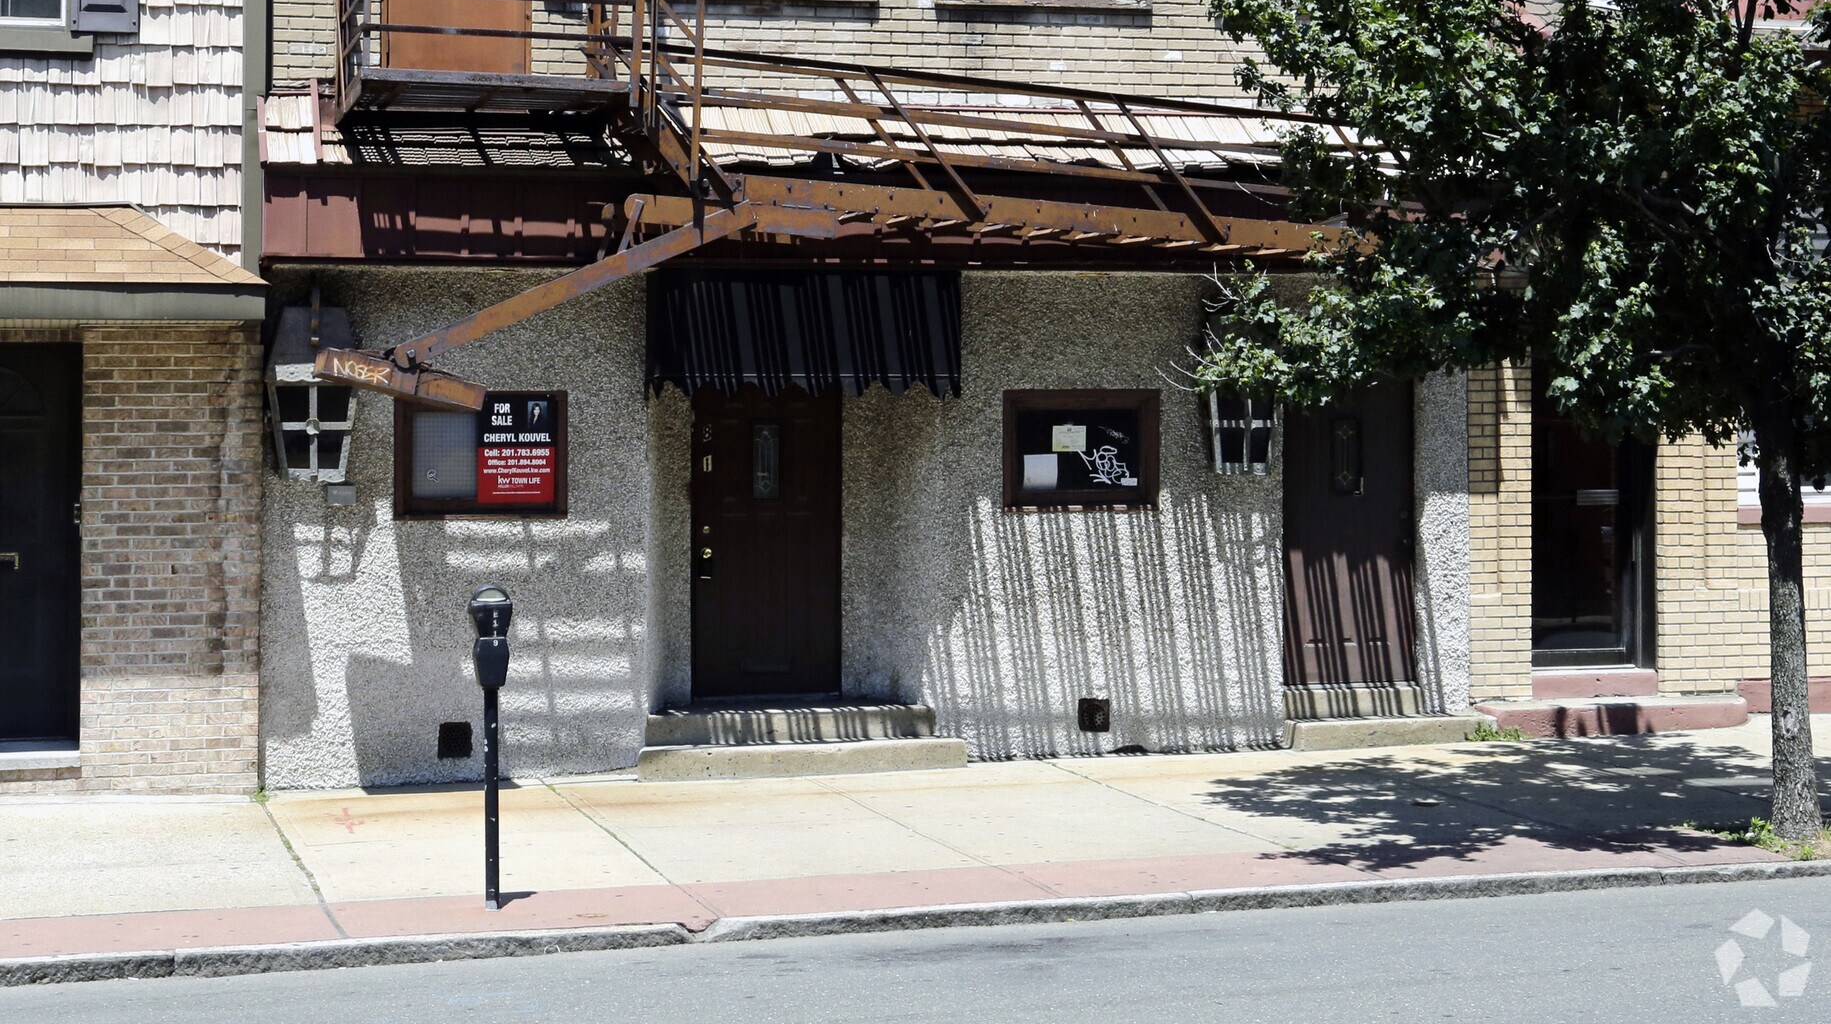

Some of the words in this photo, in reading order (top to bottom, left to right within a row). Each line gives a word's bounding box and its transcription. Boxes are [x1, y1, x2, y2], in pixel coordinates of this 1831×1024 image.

[494, 403, 511, 414] FOR
[491, 415, 513, 426] SALE
[483, 433, 517, 443] CHERYL
[518, 433, 551, 442] KOUVEL
[484, 449, 500, 457] Cell:
[501, 448, 550, 457] 201.783.6955
[497, 475, 510, 485] kw
[511, 477, 528, 485] TOWN
[528, 477, 541, 485] LIFE
